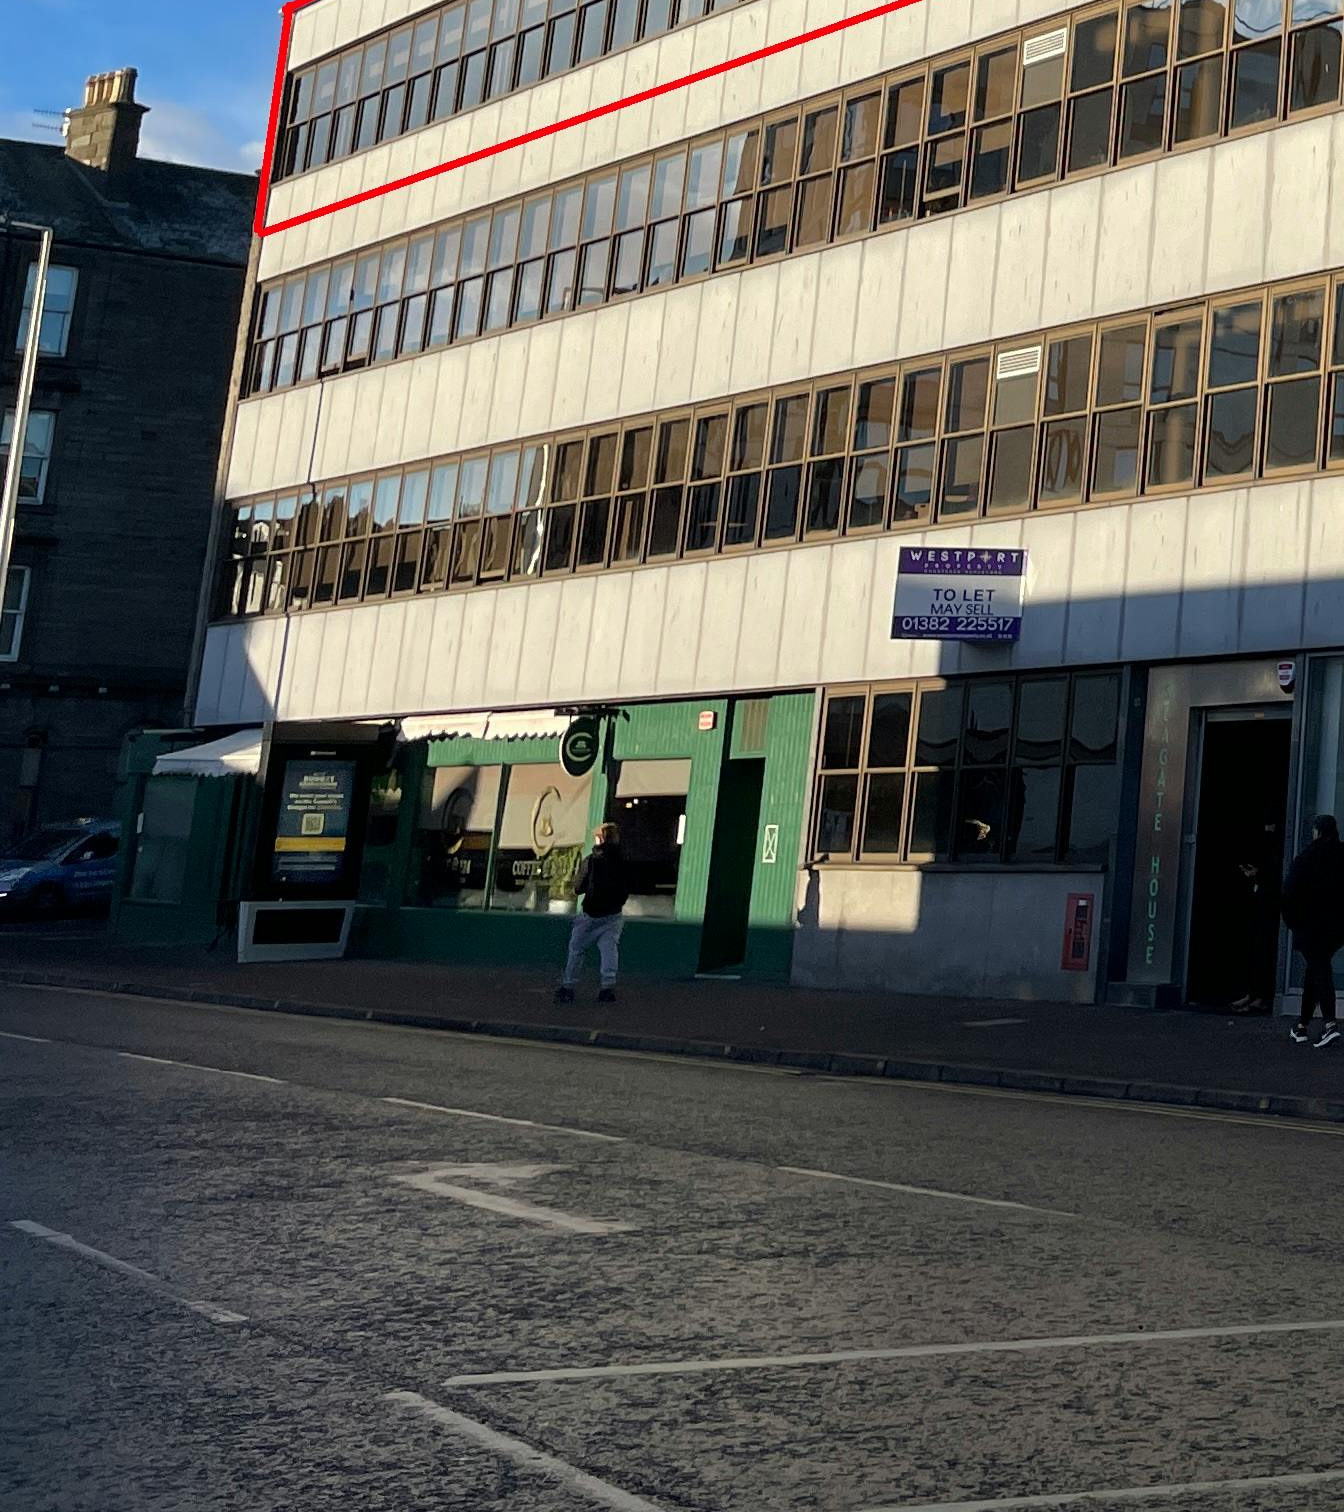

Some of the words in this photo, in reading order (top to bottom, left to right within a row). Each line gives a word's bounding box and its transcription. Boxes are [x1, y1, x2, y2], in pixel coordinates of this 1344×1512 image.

[933, 589, 956, 601] TO
[963, 589, 996, 602] LET
[930, 603, 964, 615] MAY
[965, 603, 995, 616] SELL
[902, 617, 950, 631] 01382
[956, 617, 1014, 632] 225517
[1145, 855, 1161, 965] HOUSE
